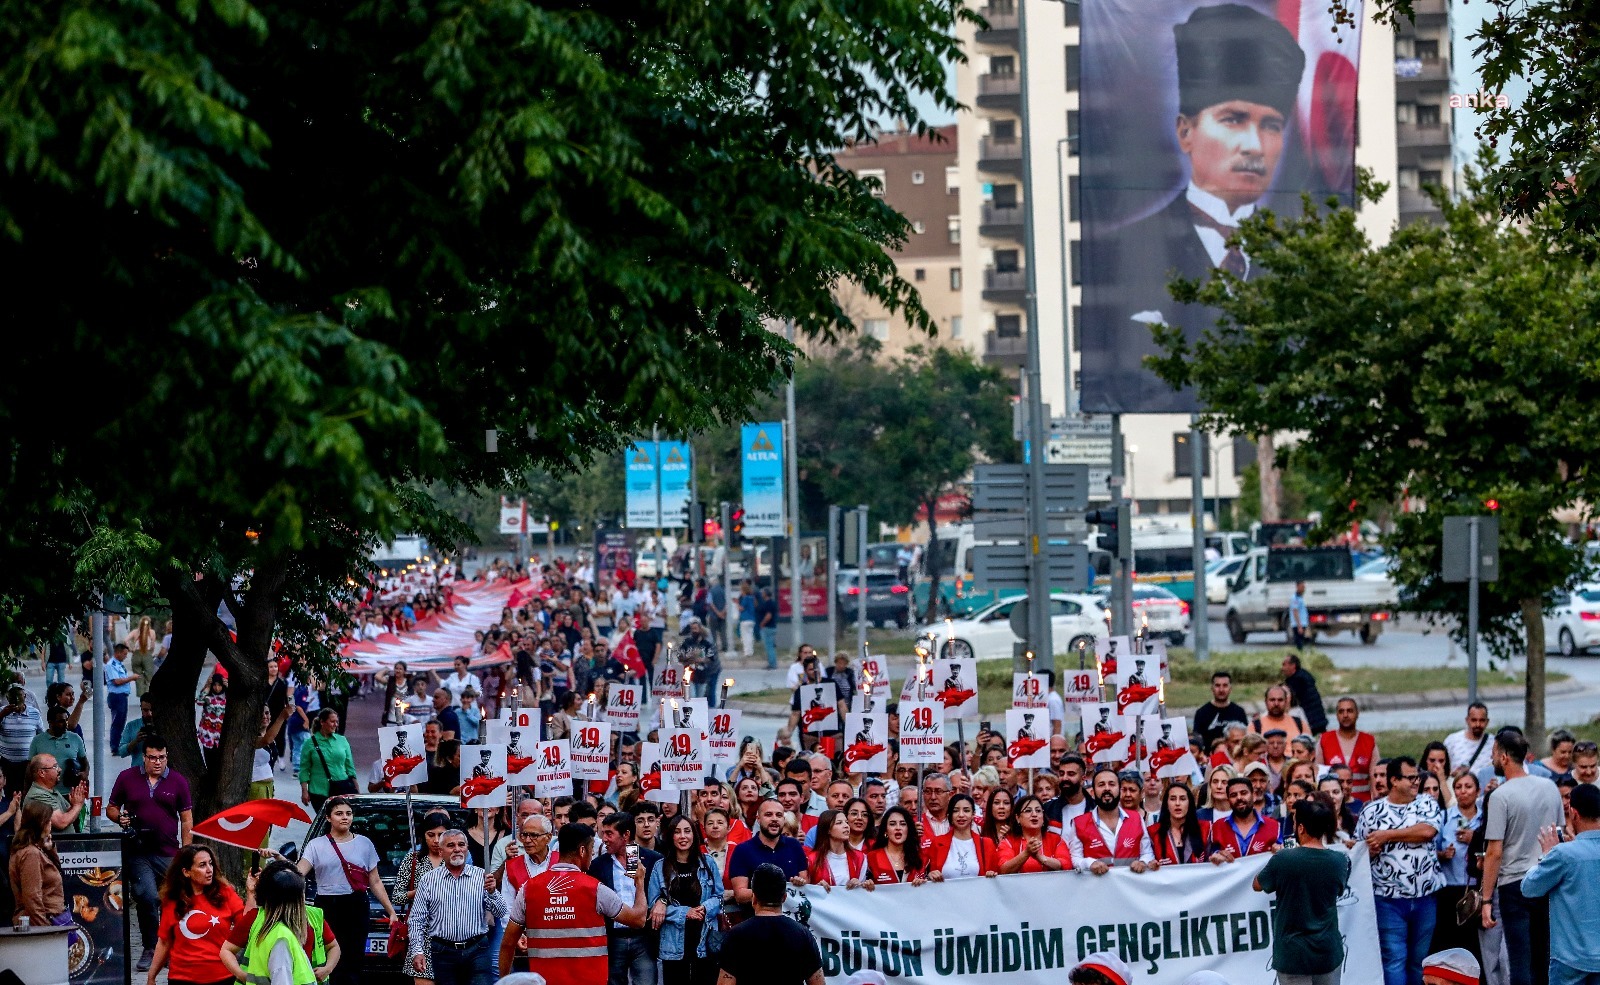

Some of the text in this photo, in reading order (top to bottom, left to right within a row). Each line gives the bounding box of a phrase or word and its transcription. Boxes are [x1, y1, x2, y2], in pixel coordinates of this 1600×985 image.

[662, 669, 676, 685] 19
[1074, 674, 1090, 692] 19
[618, 690, 634, 706] 19
[608, 710, 624, 718] KUTLU
[912, 707, 932, 730] 19
[714, 714, 730, 734] 19
[580, 728, 600, 748] 19
[670, 734, 690, 755] 19
[709, 740, 718, 748] TLU
[543, 746, 560, 767] 19
[570, 754, 608, 764] KUTLU OLSUN
[662, 763, 702, 772] KUTLU OLSUN
[537, 772, 570, 782] KUTLU OLSUN
[72, 854, 98, 866] çorba
[550, 896, 568, 904] CHP
[544, 906, 574, 914] BAYRAKLI
[372, 940, 385, 952] 35
[820, 930, 923, 978] BÜTÜN
[934, 922, 1064, 976] ÜMİDİM
